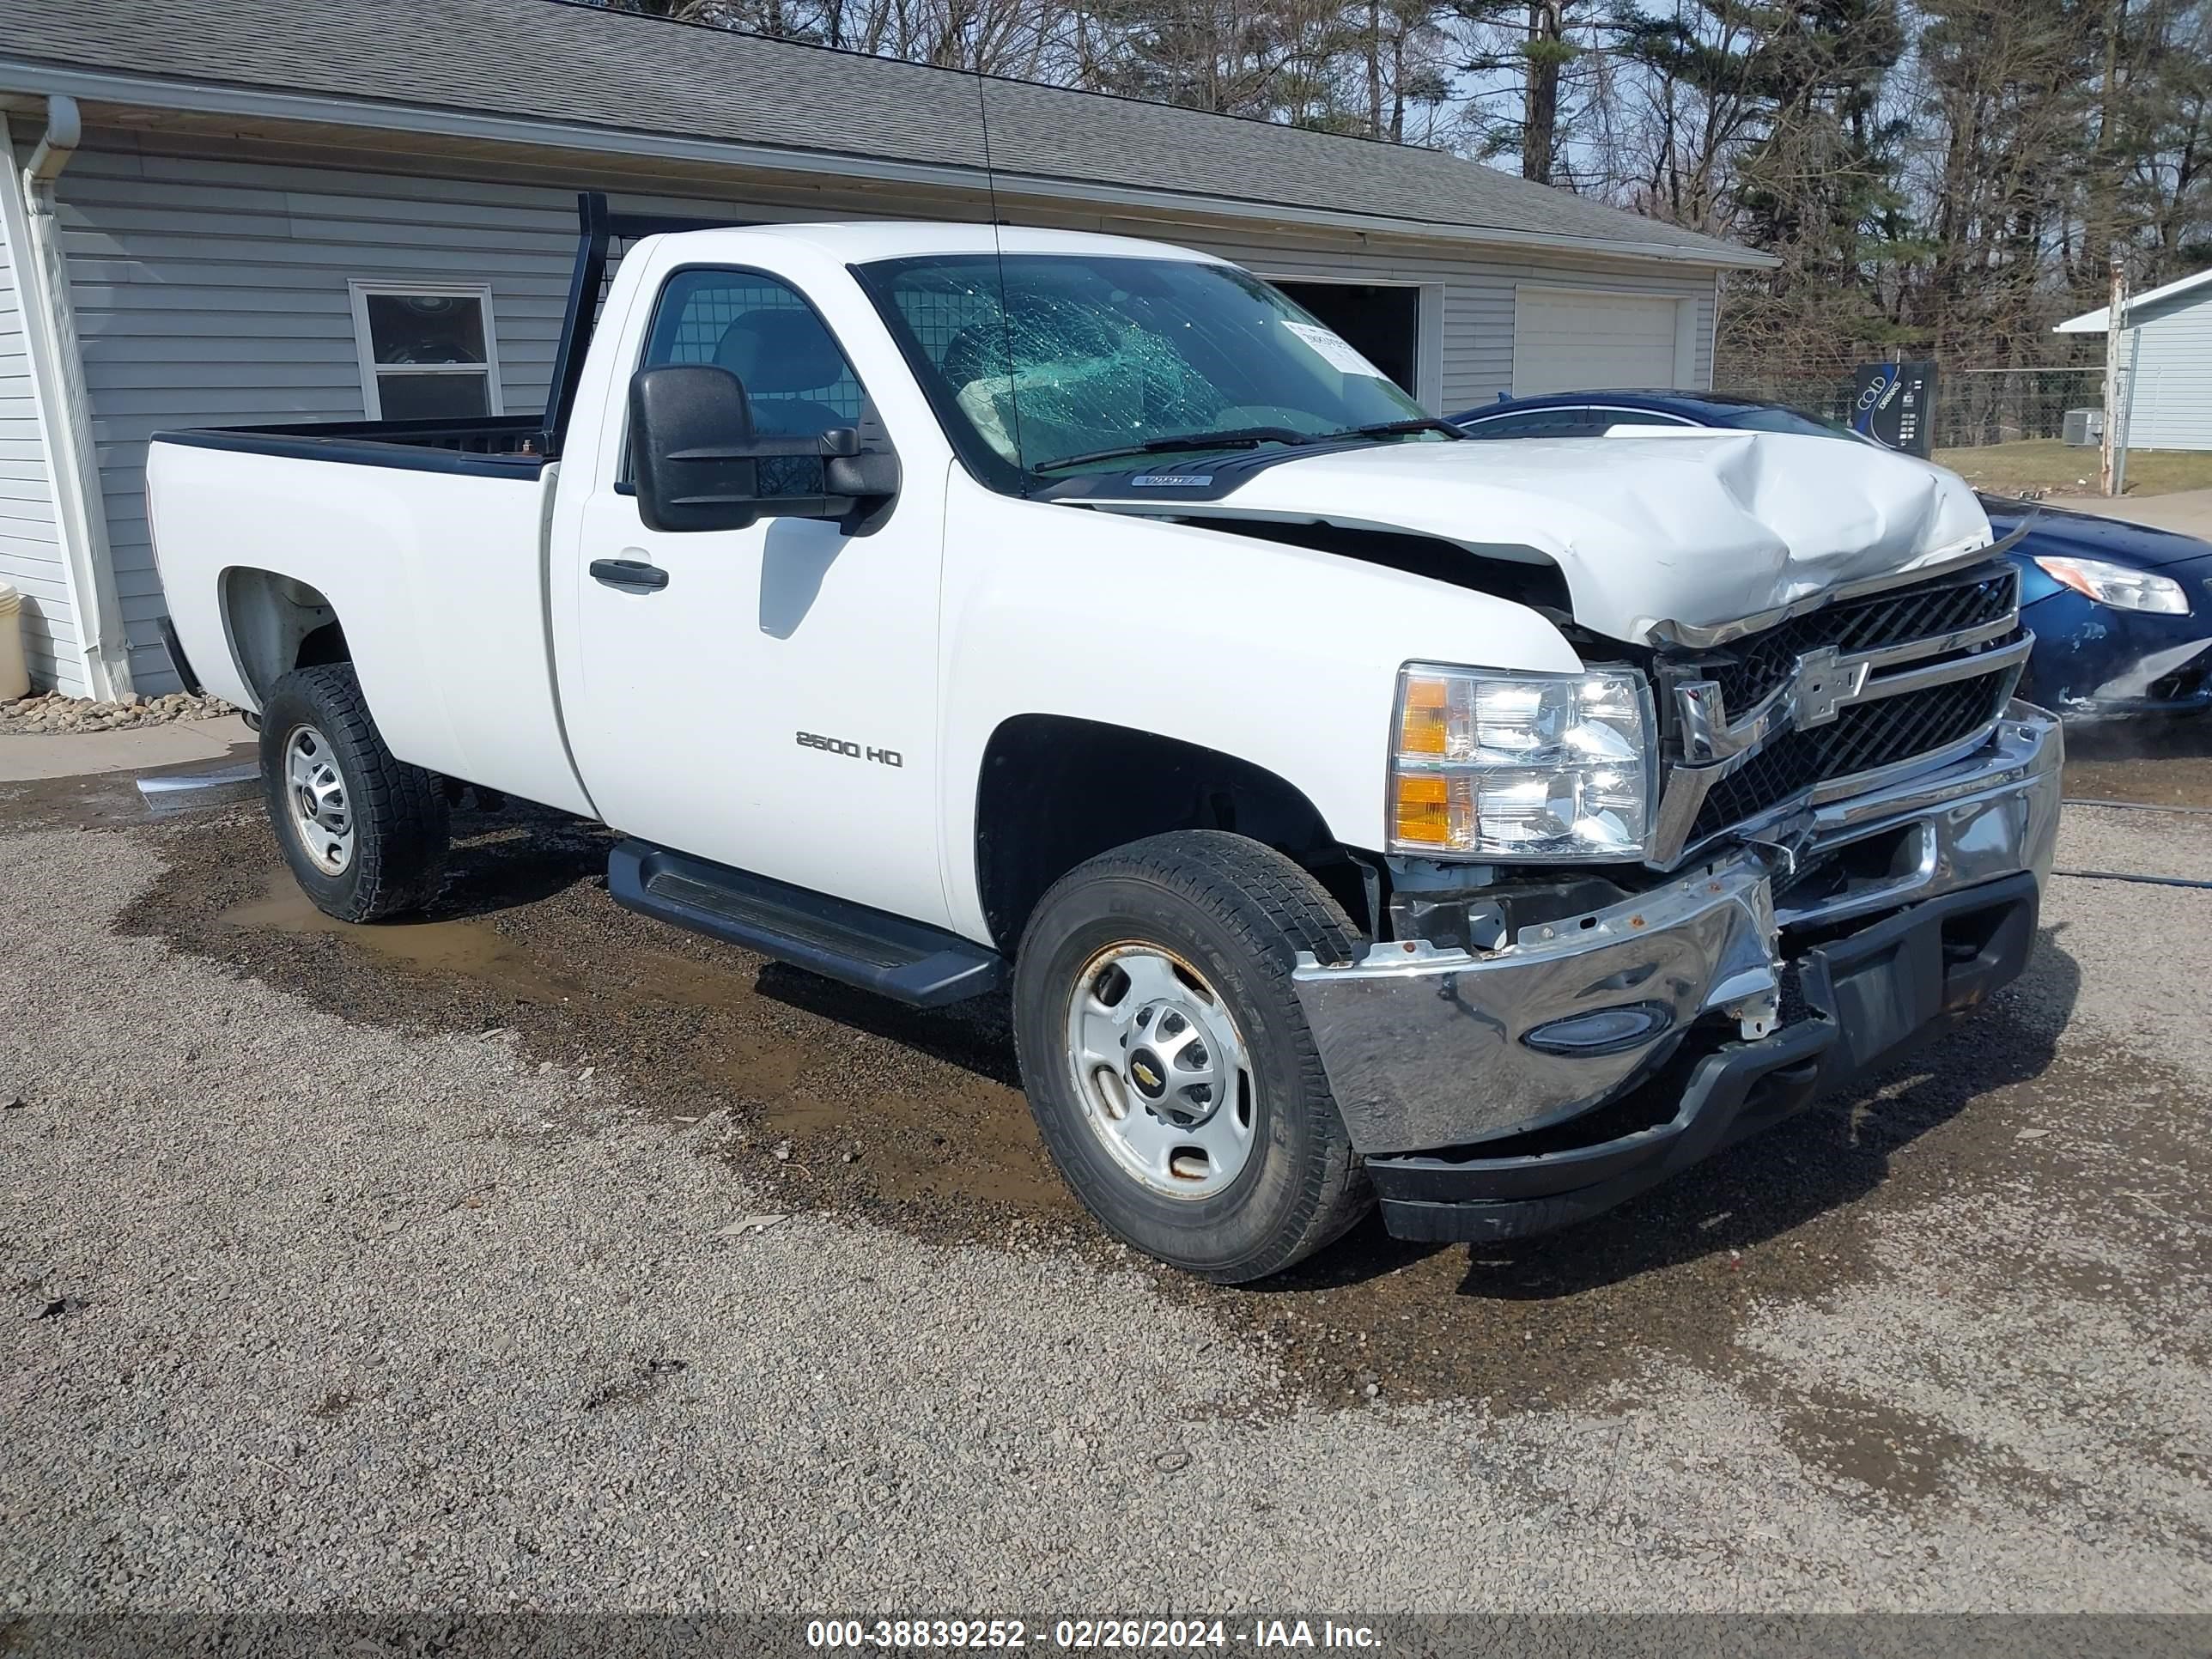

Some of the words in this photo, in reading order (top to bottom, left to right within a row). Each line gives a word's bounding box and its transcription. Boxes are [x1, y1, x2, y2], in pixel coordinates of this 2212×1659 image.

[1858, 376, 1887, 410] COLD
[1879, 381, 1901, 410] DRINKS
[796, 731, 861, 758] 2500
[866, 745, 903, 768] HD
